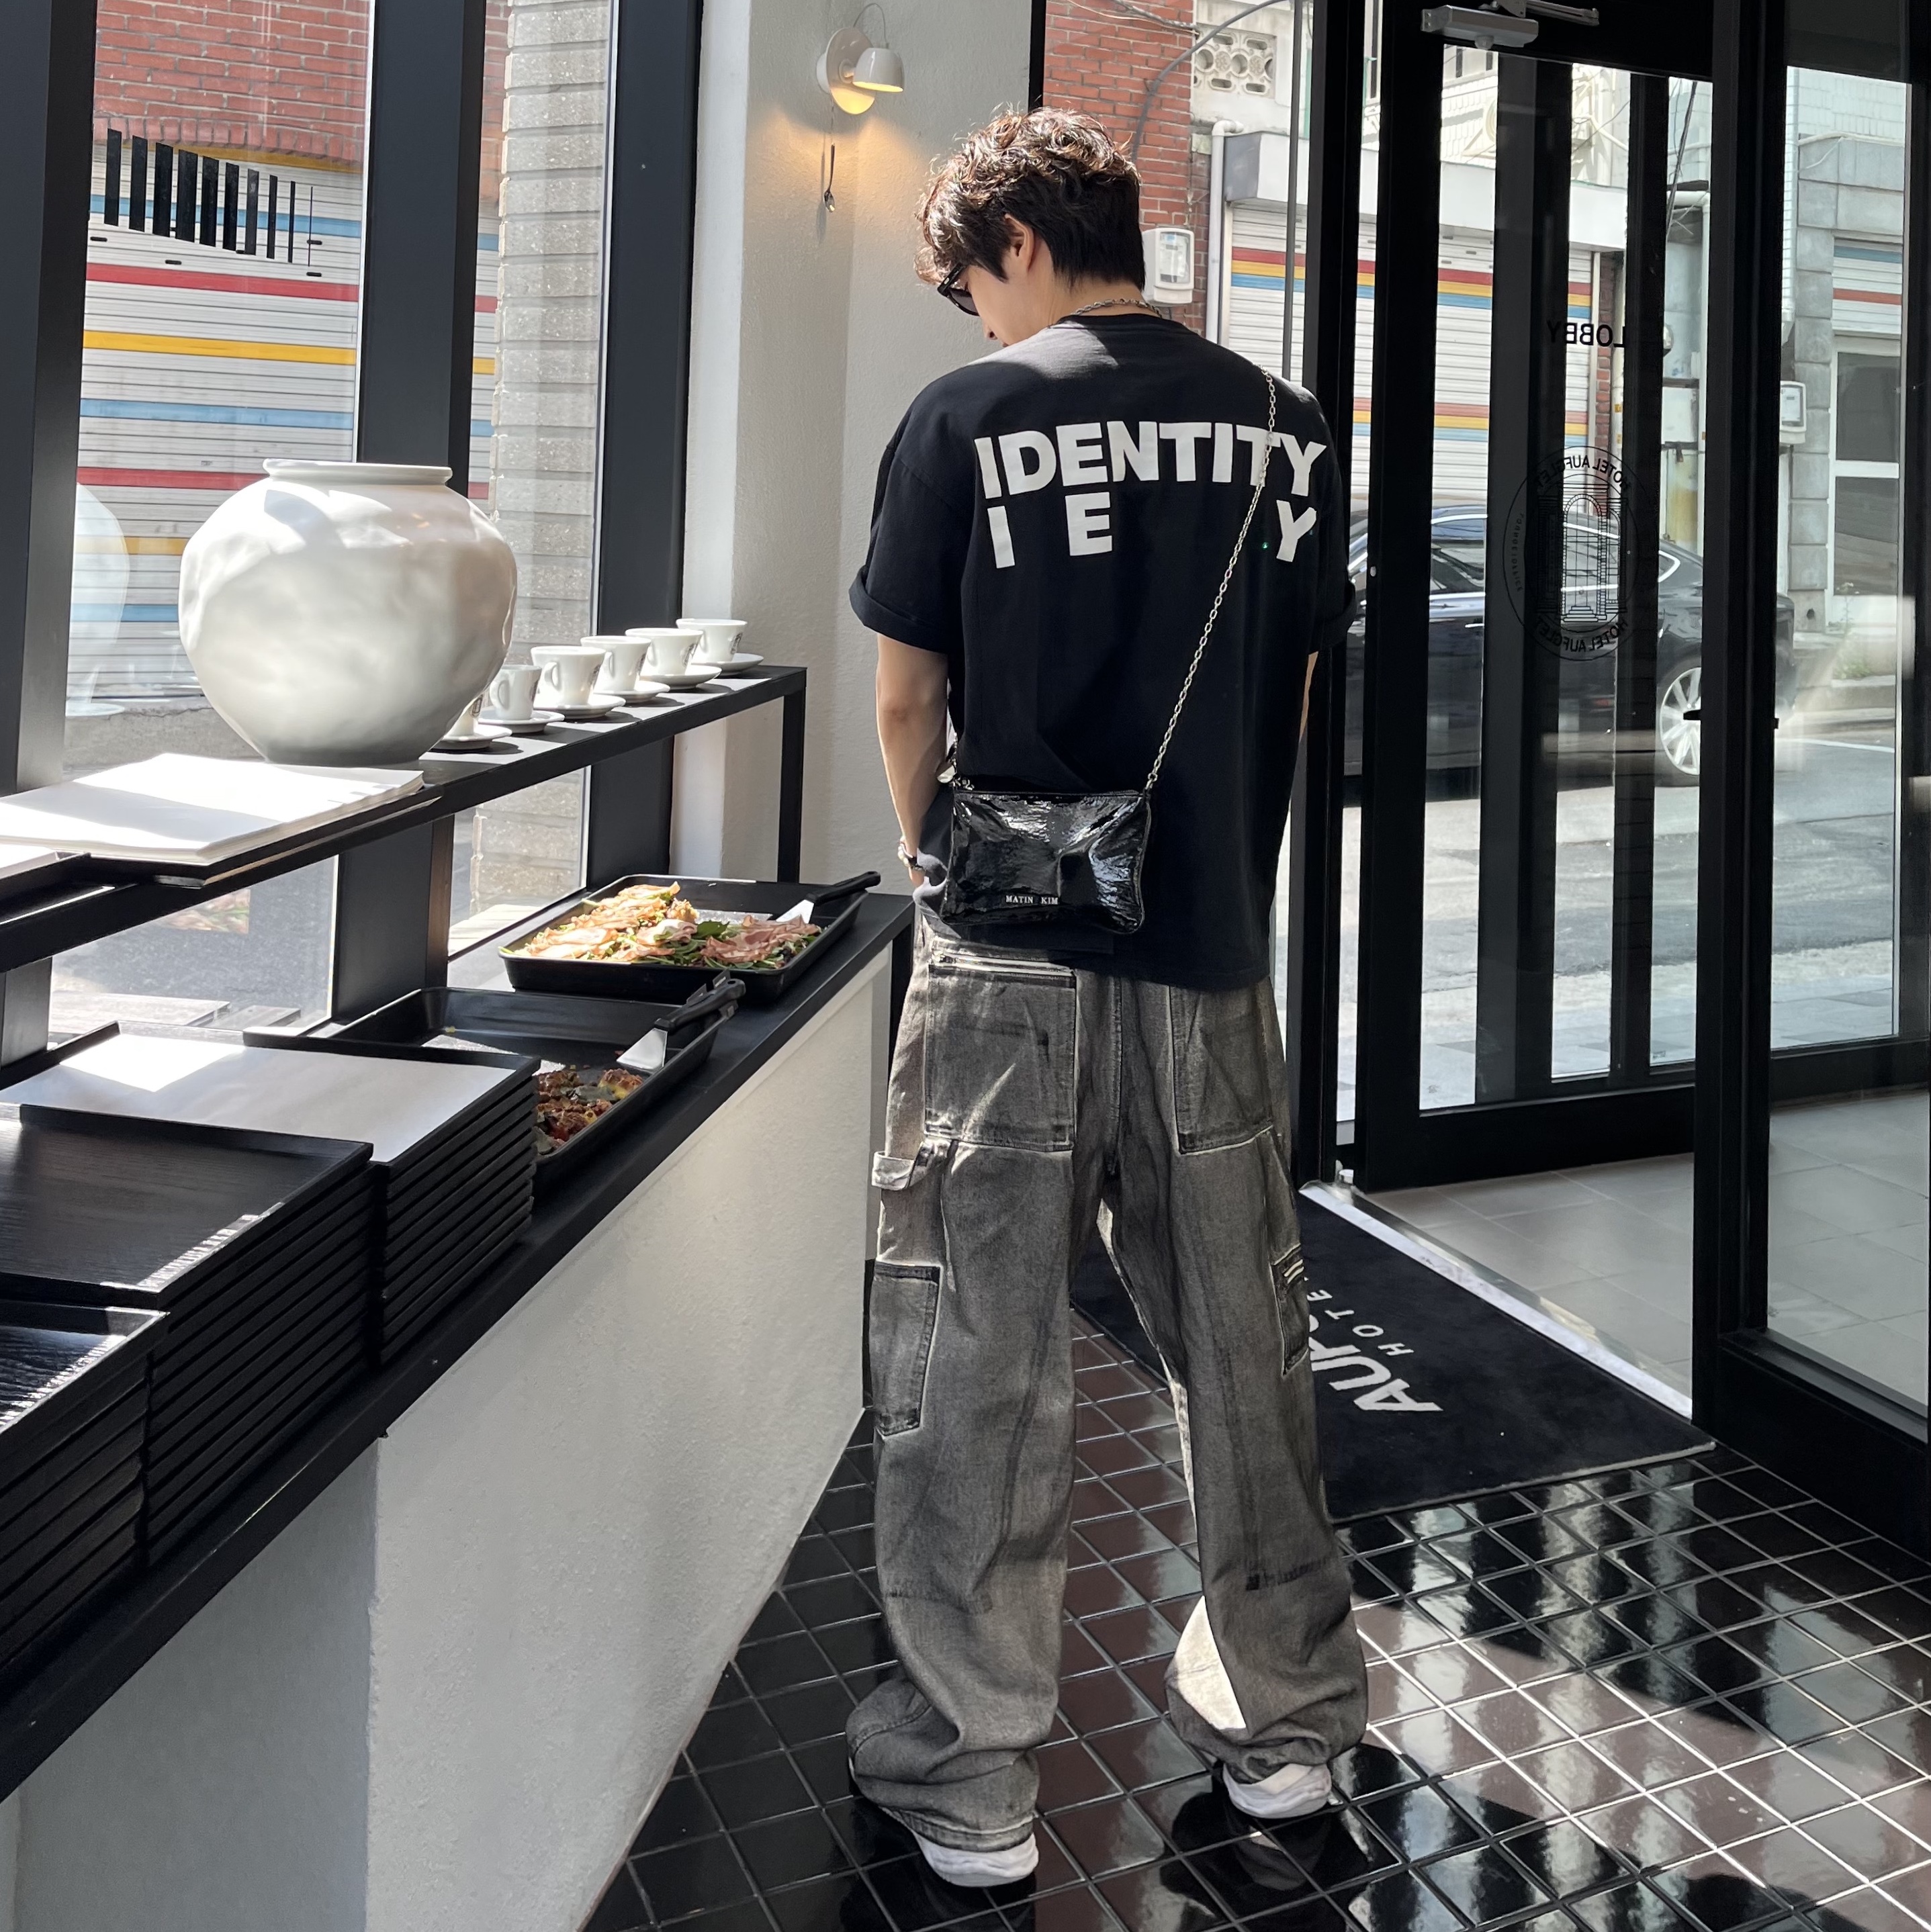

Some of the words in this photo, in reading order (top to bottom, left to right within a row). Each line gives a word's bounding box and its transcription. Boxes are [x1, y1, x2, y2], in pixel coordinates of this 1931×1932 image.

[975, 420, 1327, 499] IDENTITY
[1005, 895, 1034, 904] MATIN
[1040, 896, 1059, 905] KIM
[1304, 1276, 1414, 1356] HOTE
[1308, 1314, 1443, 1411] AUF
